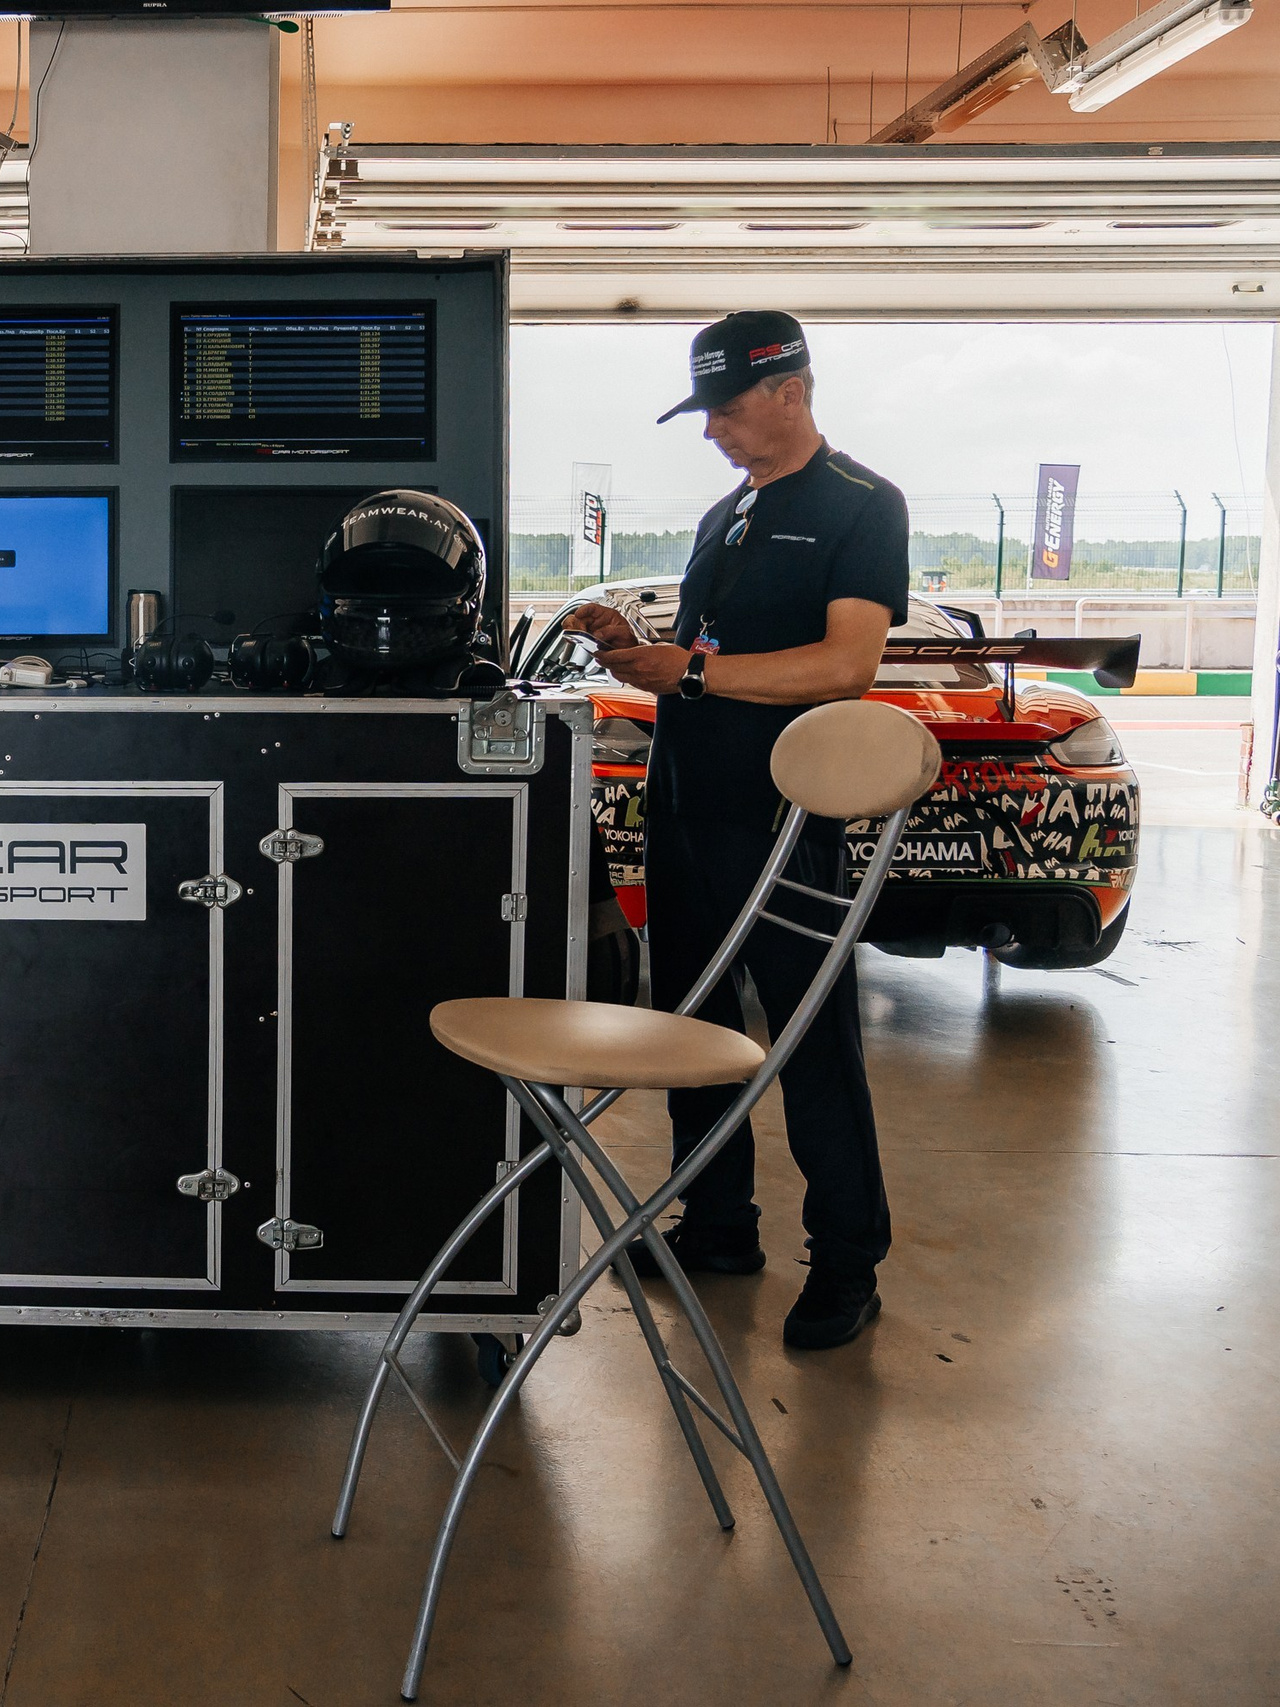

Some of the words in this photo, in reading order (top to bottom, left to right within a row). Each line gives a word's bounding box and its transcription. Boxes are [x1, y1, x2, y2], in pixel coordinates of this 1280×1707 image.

[340, 507, 450, 533] TEAMWEAR.AT
[883, 646, 1024, 655] SCHE
[604, 828, 644, 842] YOKOHA
[847, 842, 974, 861] YOOHAMA
